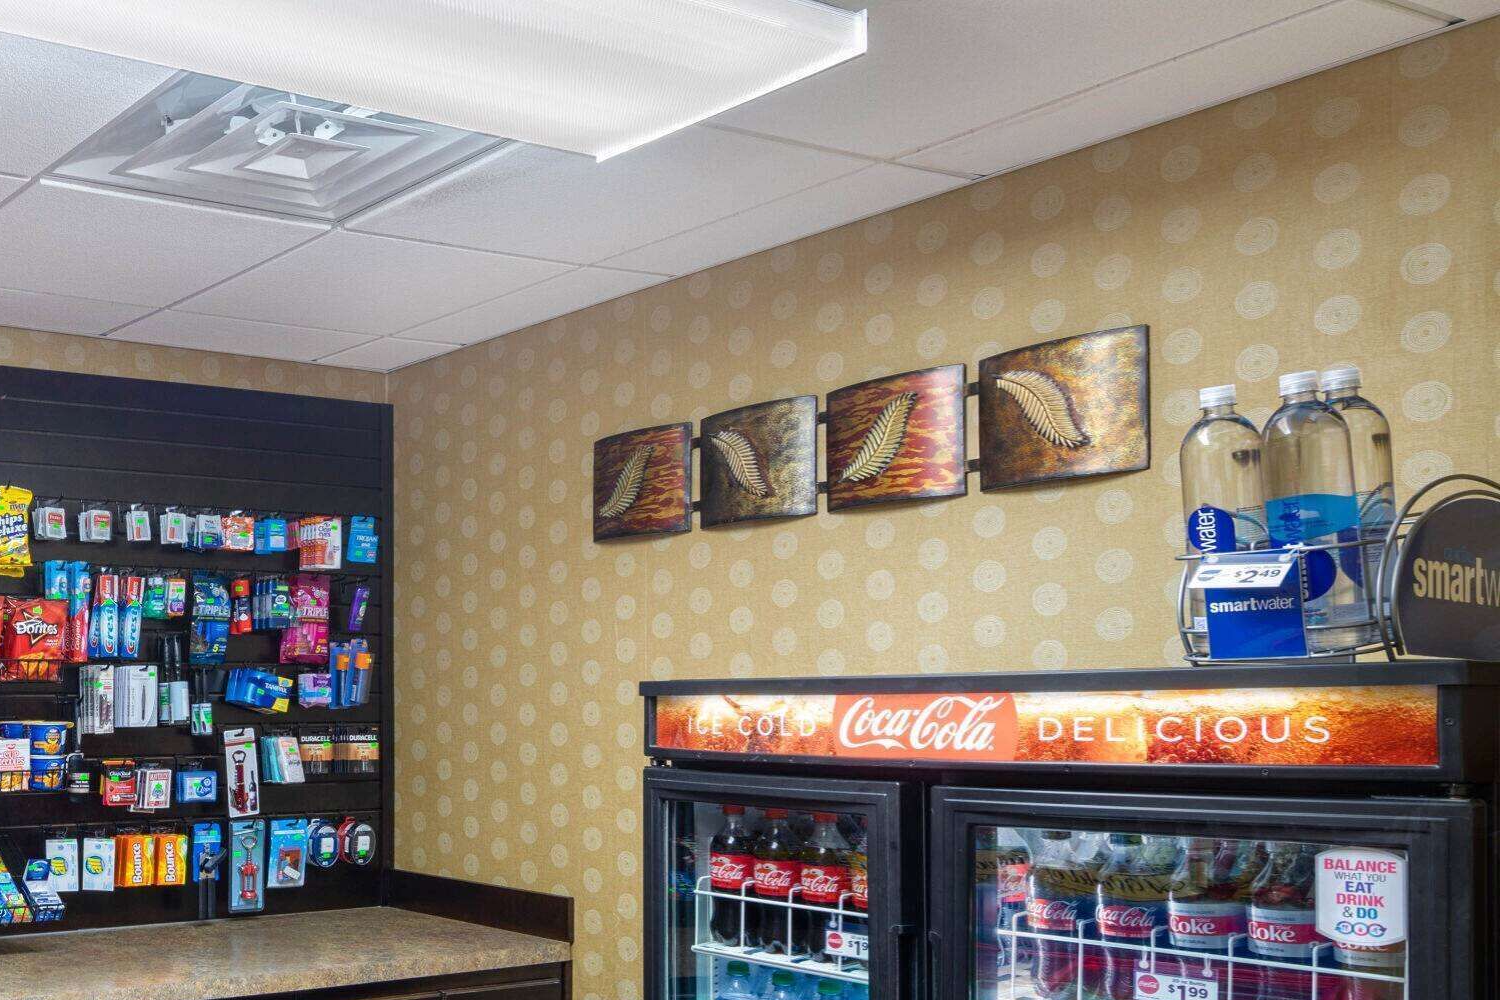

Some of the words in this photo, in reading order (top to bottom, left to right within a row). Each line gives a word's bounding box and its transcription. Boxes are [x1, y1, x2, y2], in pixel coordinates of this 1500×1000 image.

[16, 622, 58, 636] Doritos
[687, 715, 722, 735] ICE
[738, 714, 818, 738] COLD
[839, 695, 1005, 751] Coca-Cola
[1037, 716, 1331, 744] DELICIOUS
[1323, 858, 1397, 874] BALANCE
[1334, 872, 1362, 882] WHAT
[1366, 873, 1387, 883] YOU
[1345, 881, 1374, 894] EAT
[1336, 893, 1385, 908] DRINK
[1342, 906, 1353, 918] &
[1356, 908, 1378, 919] DO
[1171, 915, 1215, 935] Coke
[1249, 920, 1295, 942] Coke
